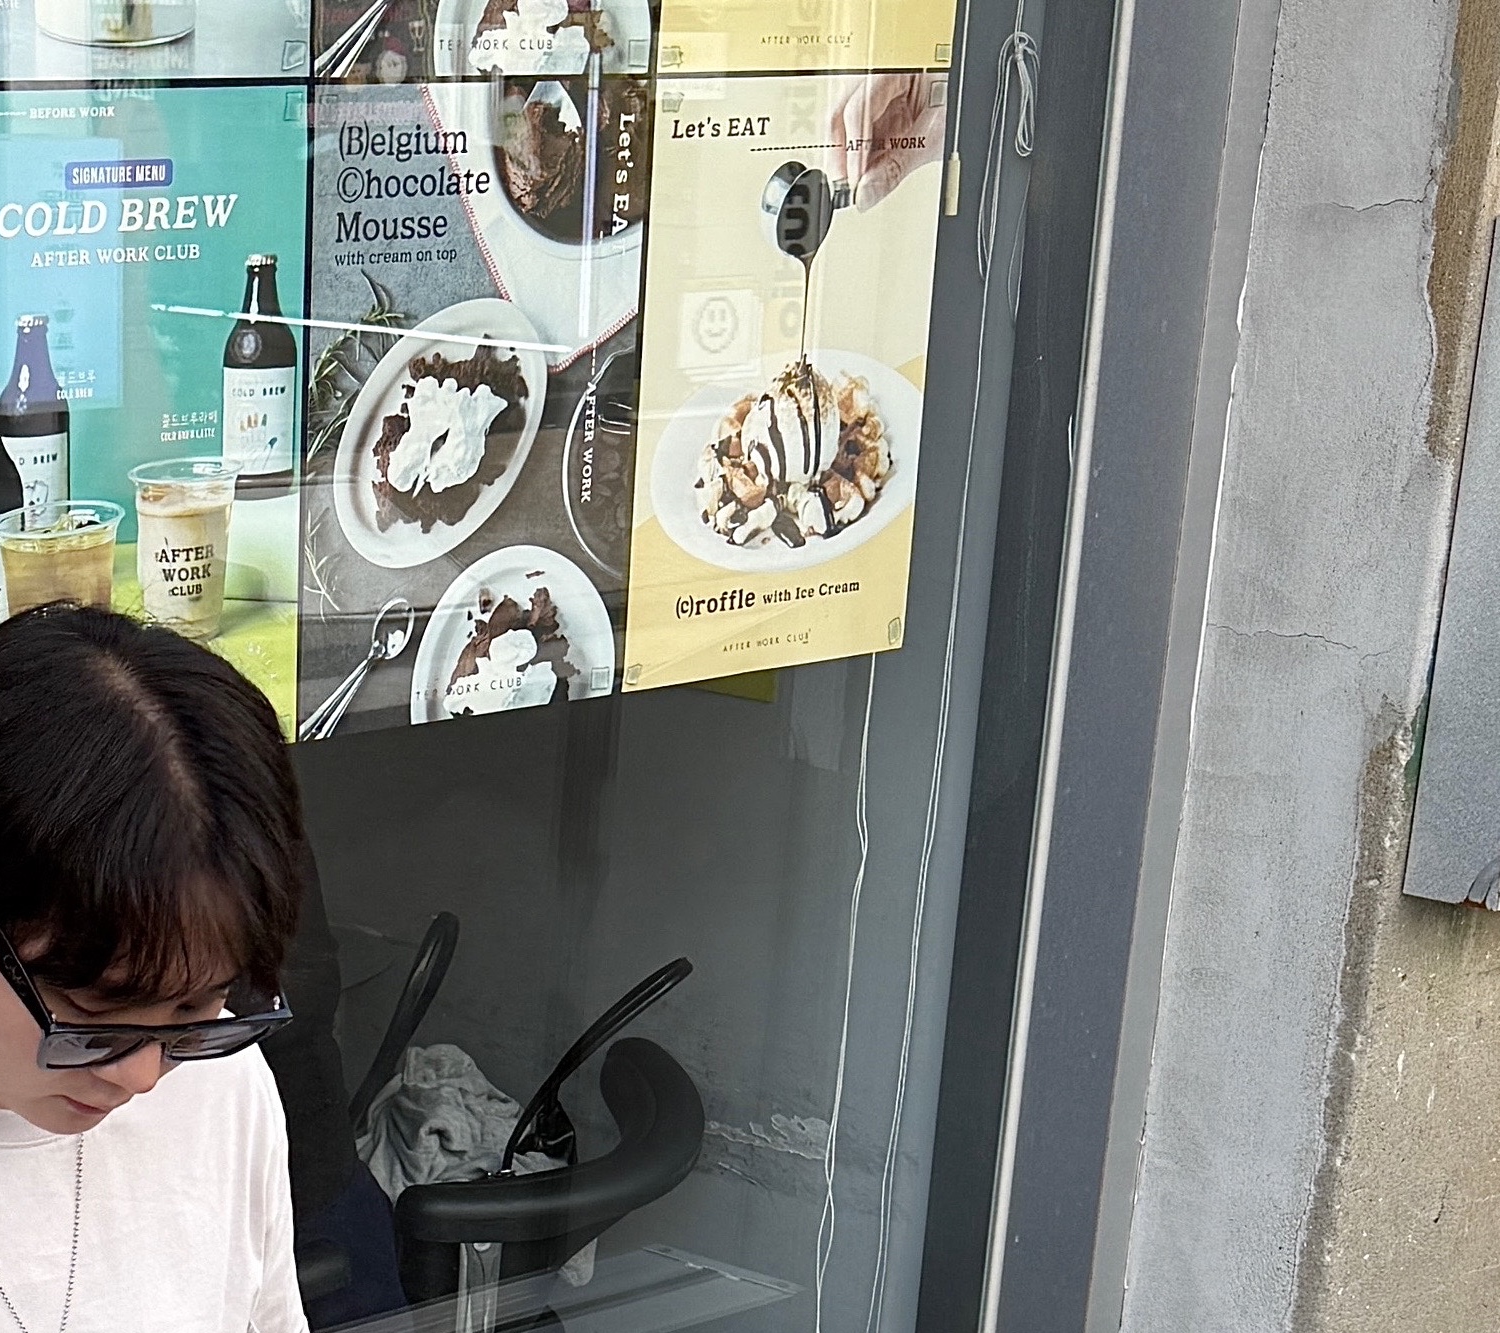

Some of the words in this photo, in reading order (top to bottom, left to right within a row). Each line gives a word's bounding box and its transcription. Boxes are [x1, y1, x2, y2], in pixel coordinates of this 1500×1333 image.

[519, 39, 553, 50] CLUB
[29, 107, 76, 119] BEFORE
[79, 106, 115, 117] WORK
[672, 117, 721, 139] Let's
[726, 117, 770, 137] EAT
[615, 113, 636, 184] Let's
[890, 136, 926, 149] WORK
[72, 165, 132, 185] SIGNATURE
[135, 164, 166, 183] MENU
[117, 194, 238, 232] BREW
[336, 211, 448, 243] Mousse
[30, 250, 90, 268] AFTER
[98, 246, 149, 264] WORK
[154, 244, 200, 261] CLUB
[335, 252, 365, 266] with
[369, 251, 412, 264] cream
[416, 251, 433, 262] on
[436, 247, 457, 263] top
[584, 382, 597, 443] AFTER
[580, 447, 594, 503] WORK
[158, 544, 214, 563] AFTER
[162, 563, 211, 582] WORK
[171, 583, 203, 597] CLUB
[675, 589, 755, 619] (c)roffle
[762, 590, 791, 605] with
[795, 586, 814, 600] Ice
[819, 580, 860, 597] Cream
[490, 677, 522, 690] CLUB
